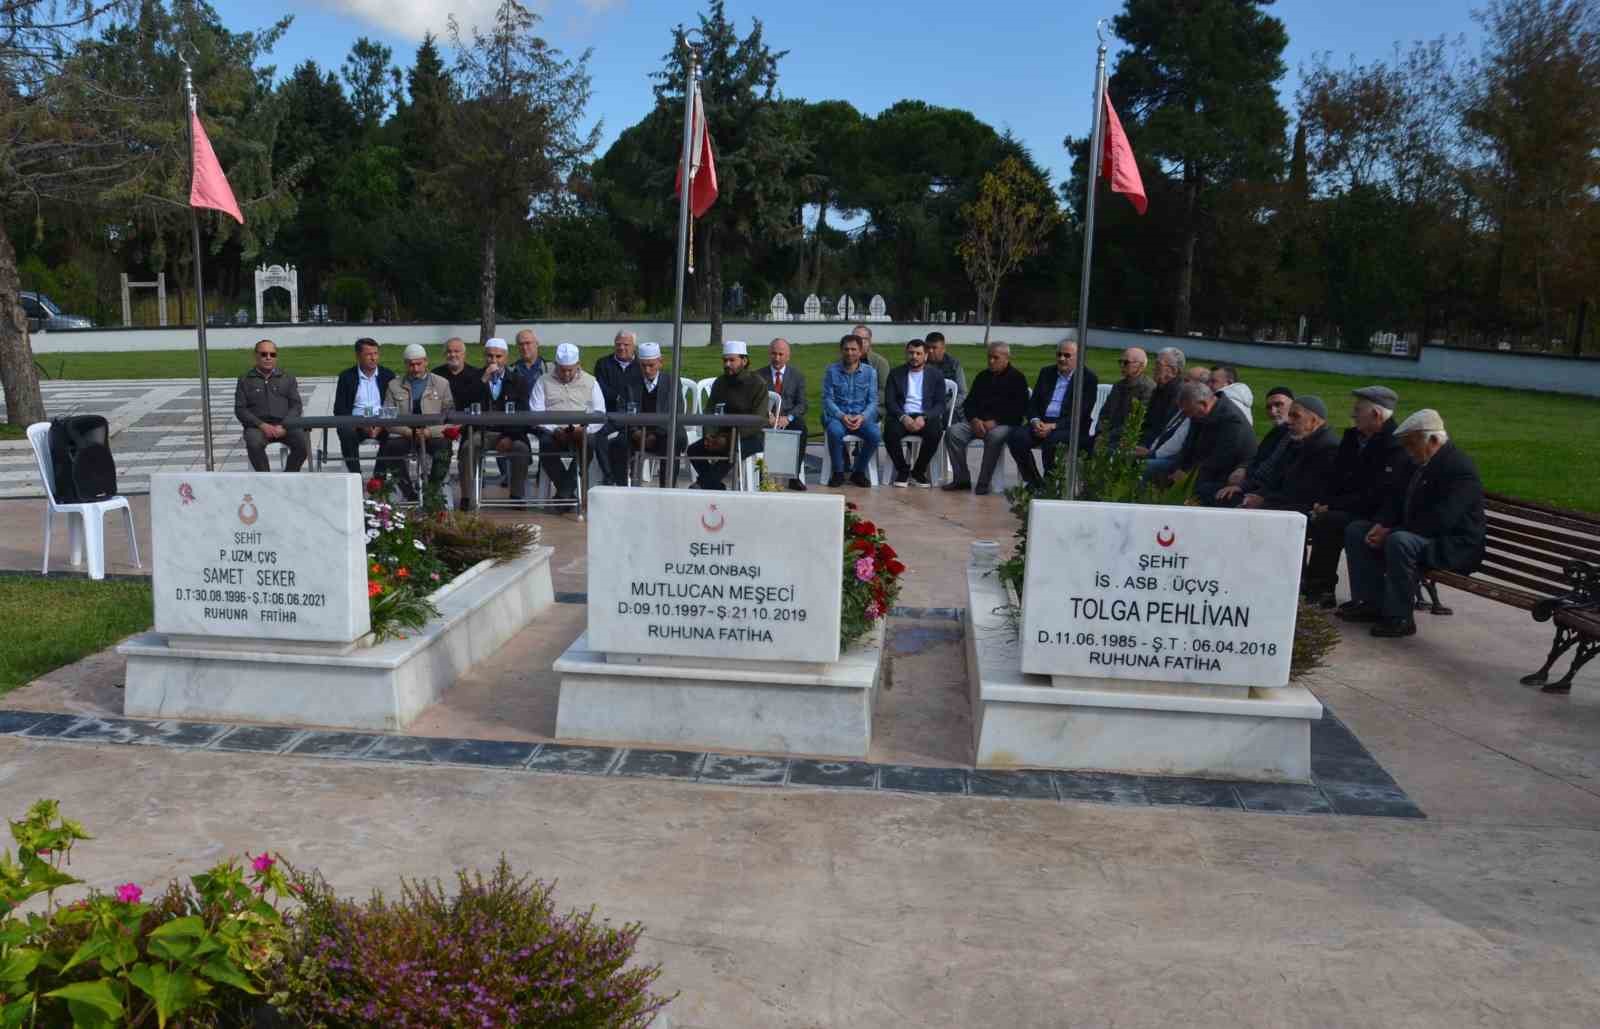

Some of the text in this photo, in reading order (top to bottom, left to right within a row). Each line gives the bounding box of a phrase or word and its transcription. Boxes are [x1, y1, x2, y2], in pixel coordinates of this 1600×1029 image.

[689, 542, 735, 557] ŞEHİT
[1138, 553, 1189, 571] ŞEHİT
[203, 568, 244, 584] SAMET
[631, 582, 794, 604] MUTLUCAN MEŞECİ
[204, 607, 296, 623] RUHUNA FATİHA
[1070, 597, 1250, 627] TOLGA PEHLİVAN
[648, 625, 773, 643] RUHUNA FATİHA
[1089, 652, 1222, 671] RUHUNA FATİHA
